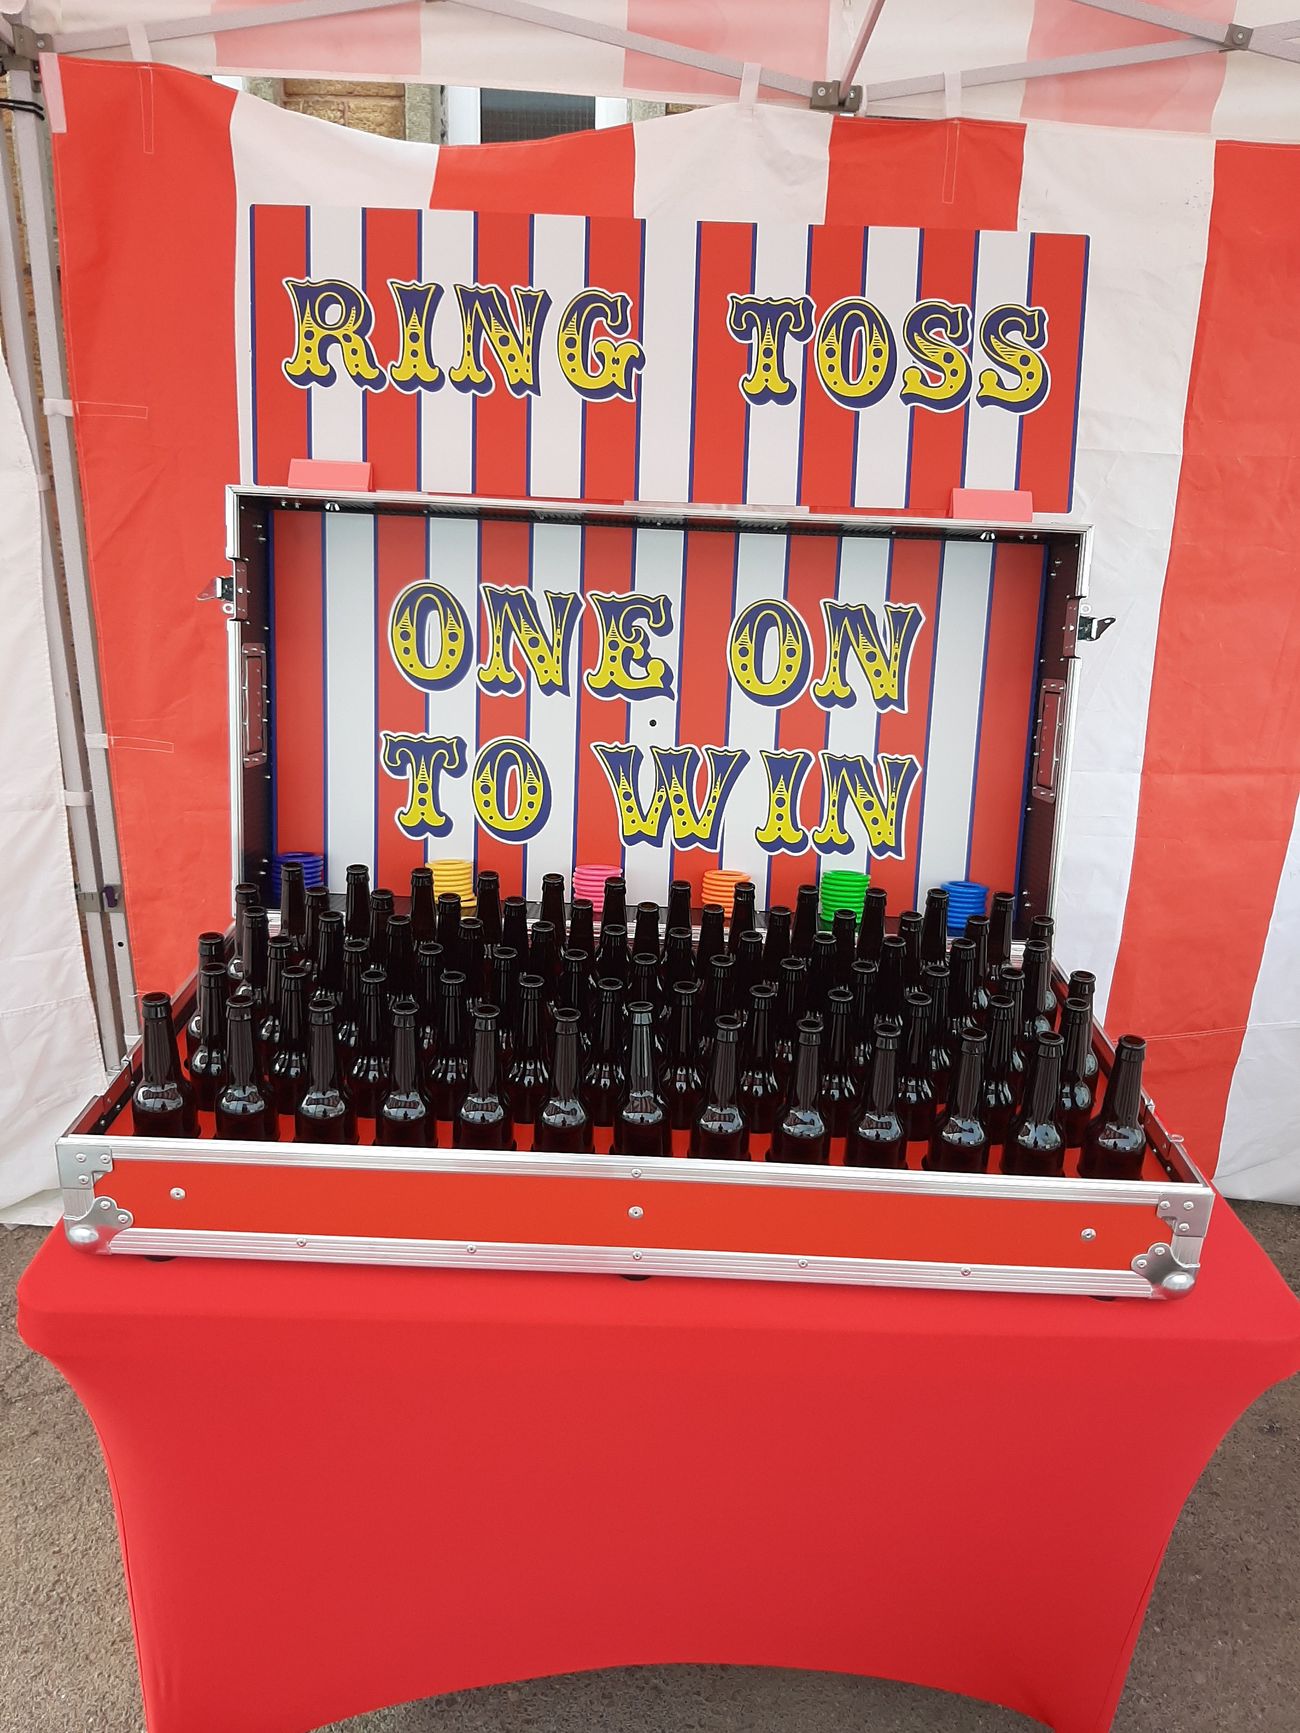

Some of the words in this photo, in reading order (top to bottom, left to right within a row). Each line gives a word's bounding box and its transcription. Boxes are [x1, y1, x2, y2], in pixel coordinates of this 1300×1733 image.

[282, 277, 645, 403] RING
[726, 294, 1051, 415] TOSS
[387, 580, 677, 701] ONE
[726, 598, 925, 714] ON
[379, 732, 553, 845] TO
[593, 741, 923, 860] WIN
